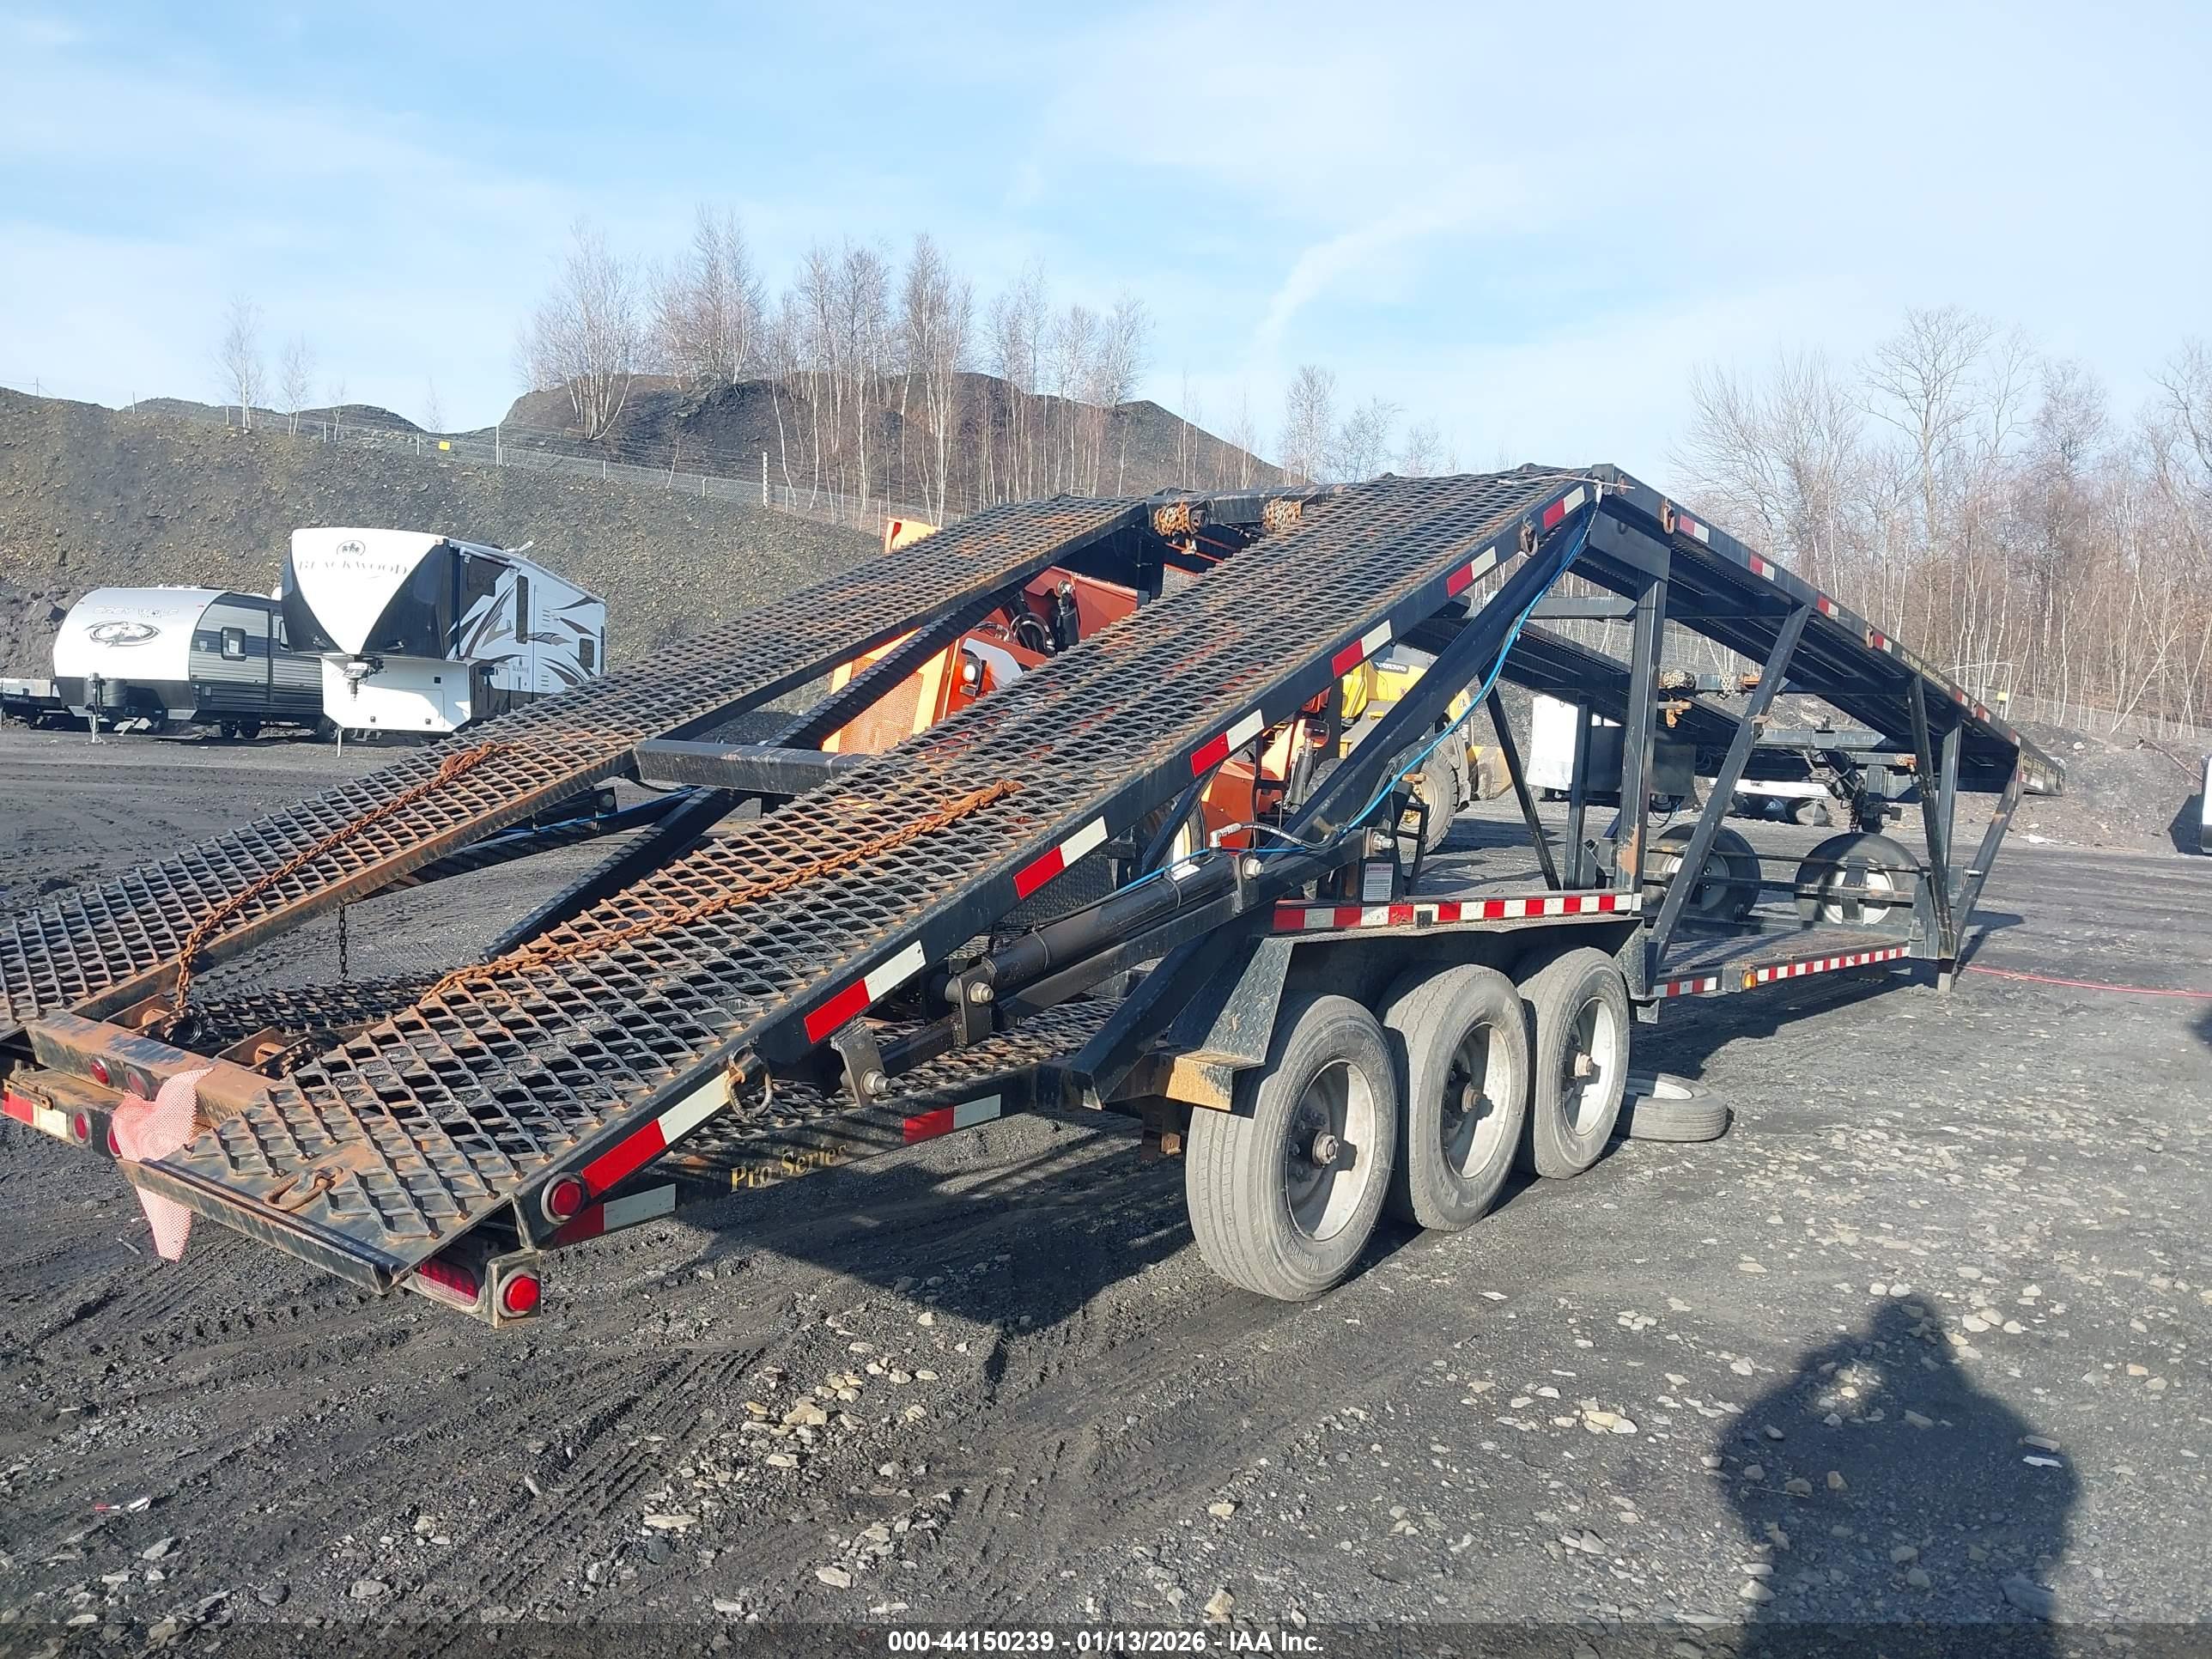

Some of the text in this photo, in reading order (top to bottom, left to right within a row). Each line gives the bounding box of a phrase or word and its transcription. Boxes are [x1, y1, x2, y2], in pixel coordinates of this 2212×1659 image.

[1374, 661, 1407, 672] VOLVO
[730, 1144, 847, 1194] Pro Series
